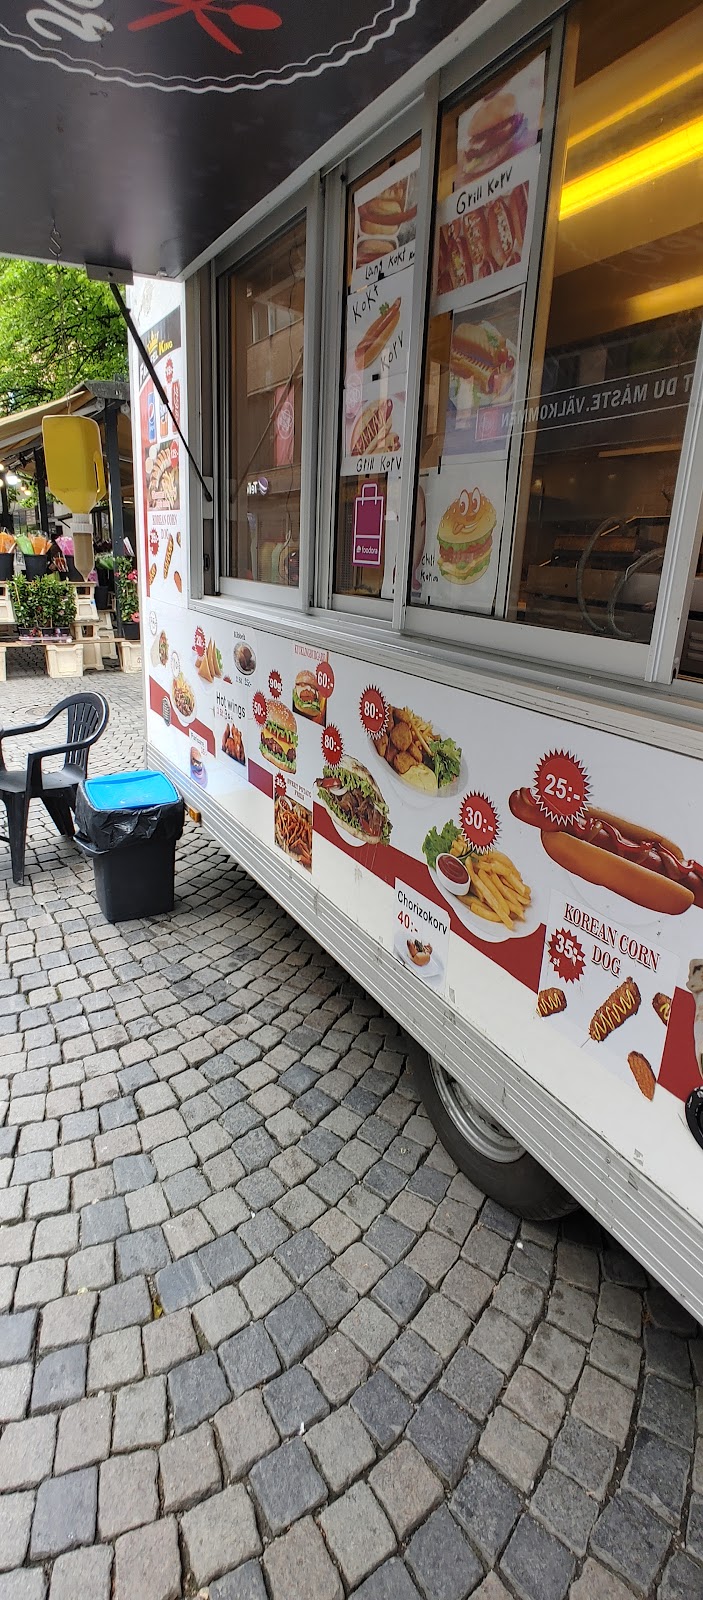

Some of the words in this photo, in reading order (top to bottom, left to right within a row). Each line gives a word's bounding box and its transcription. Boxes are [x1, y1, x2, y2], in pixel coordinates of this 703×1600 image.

[456, 188, 483, 215] Grill
[361, 545, 378, 555] foodora
[317, 671, 334, 690] 60:-
[216, 691, 226, 708] Hot
[227, 699, 246, 719] wings
[254, 702, 266, 717] 50:-
[364, 700, 383, 720] 80:-
[324, 734, 340, 752] 80:-
[544, 773, 581, 802] 25:-
[464, 806, 494, 833] 30:-
[397, 890, 448, 935] Chorizokorv
[397, 910, 419, 933] 40:-
[563, 902, 618, 948] KOREAN
[618, 933, 661, 973] CORN
[591, 944, 622, 979] DOG
